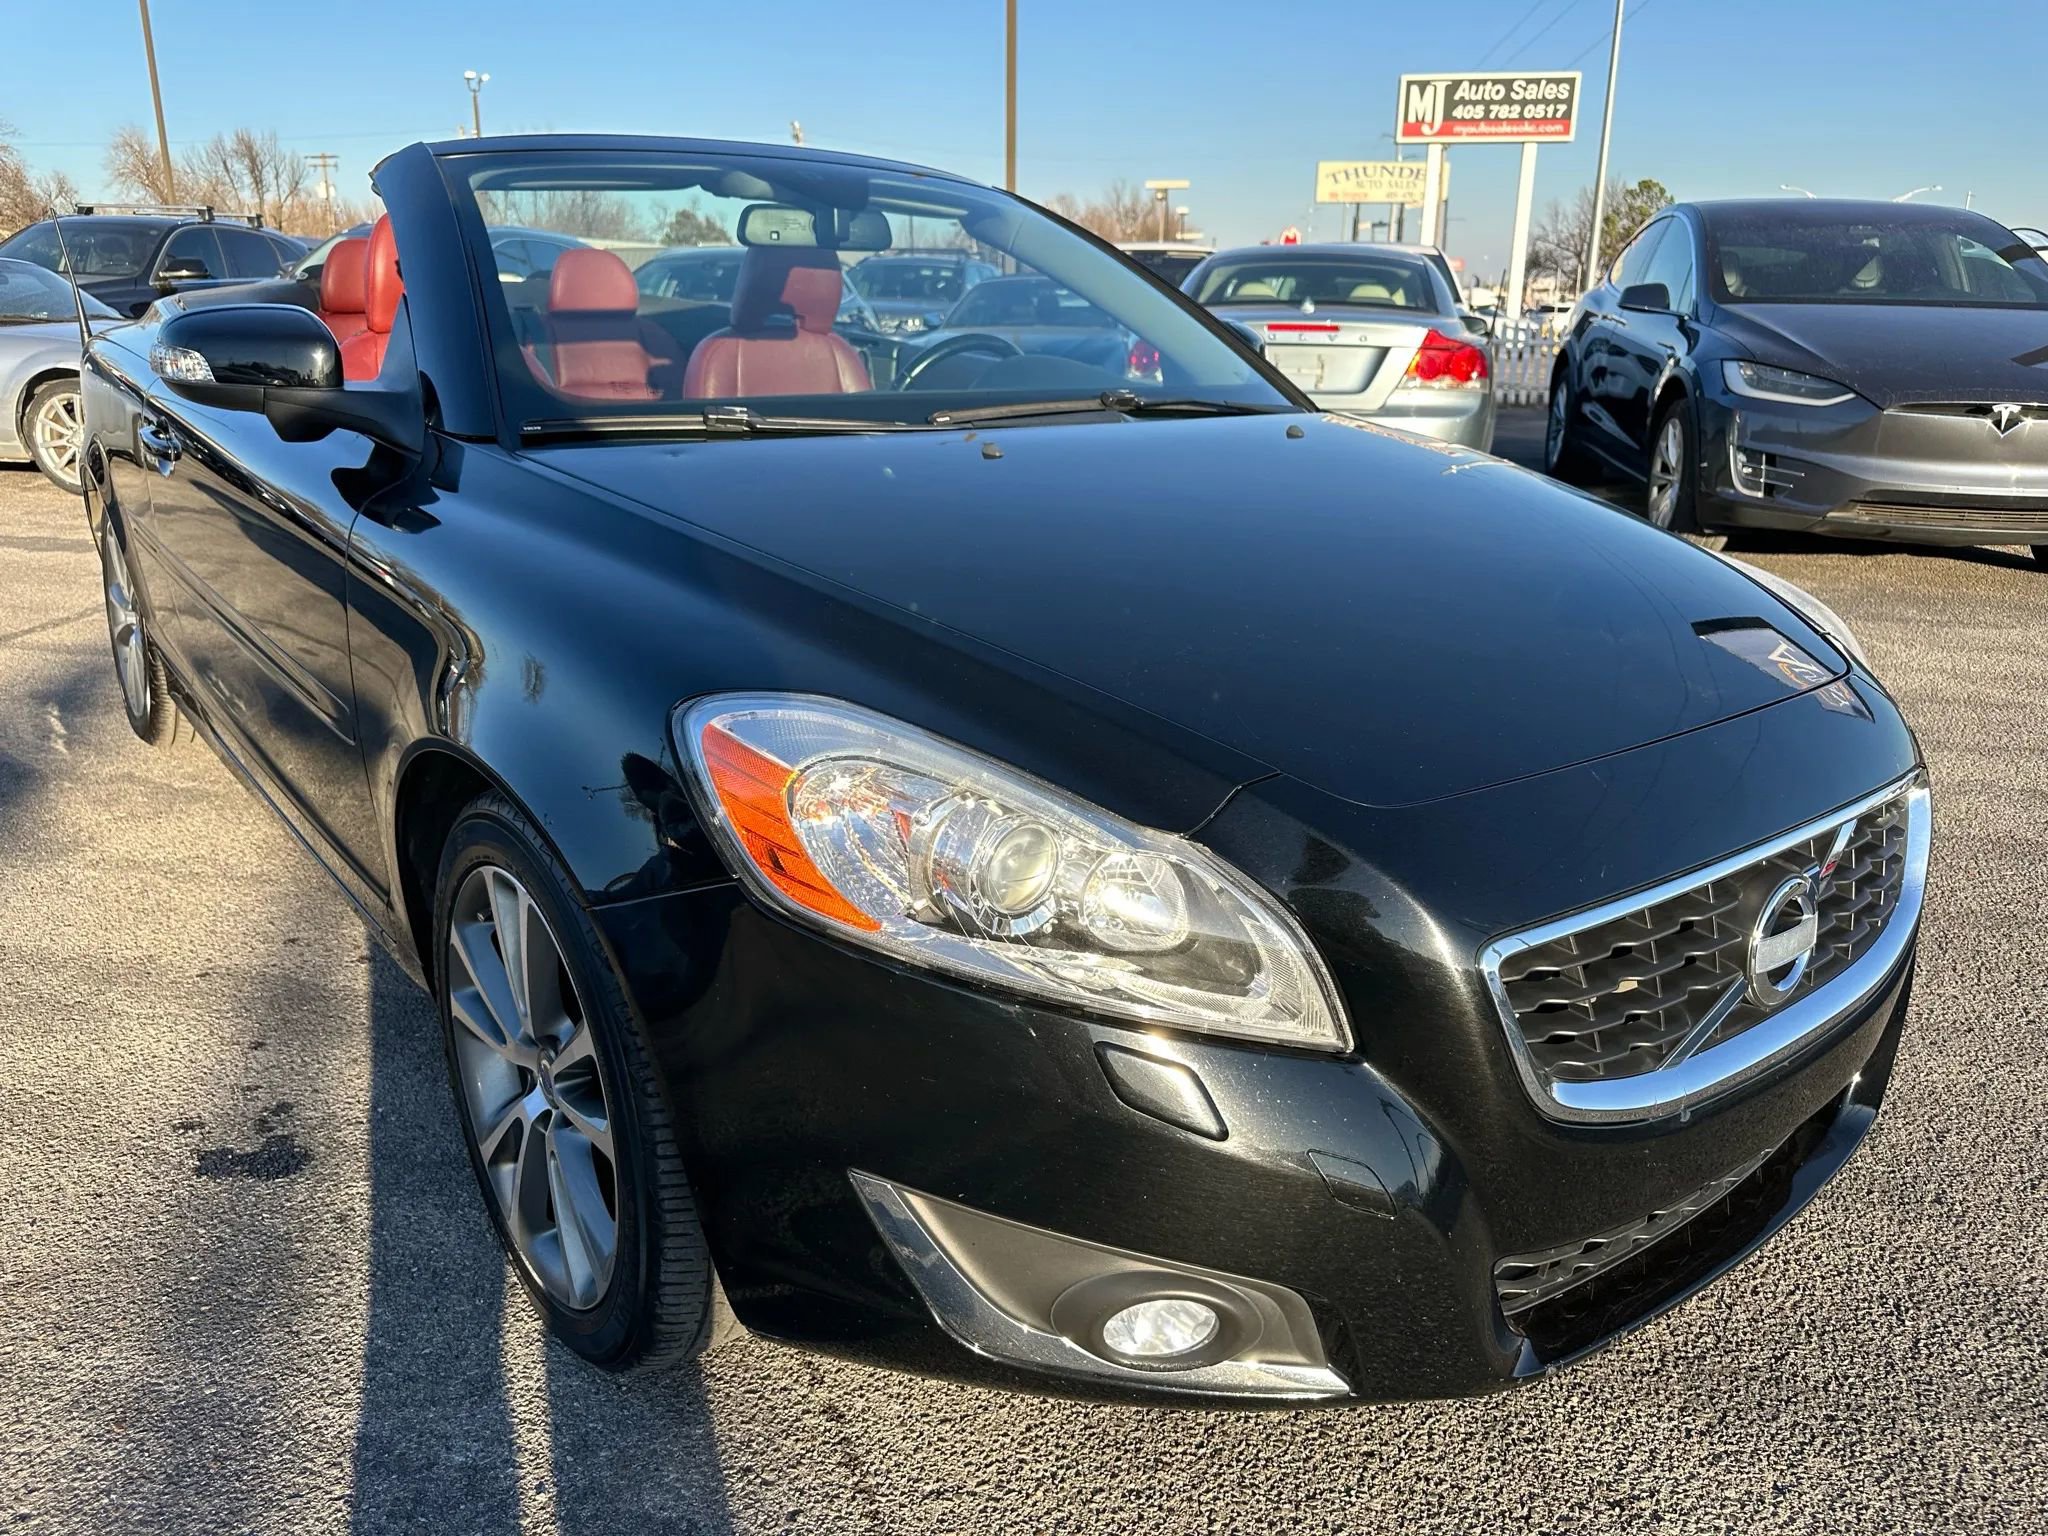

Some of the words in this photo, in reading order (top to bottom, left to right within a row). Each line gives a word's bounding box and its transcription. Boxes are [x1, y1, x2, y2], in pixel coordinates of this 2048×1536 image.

[1453, 80, 1506, 101] Auto
[1510, 79, 1571, 100] Sales
[1407, 80, 1453, 136] MJ
[1452, 104, 1485, 119] 405
[1489, 104, 1521, 119] 782
[1523, 103, 1568, 119] 0517
[1326, 164, 1426, 185] THUNDE
[1268, 333, 1368, 343] OLVO
